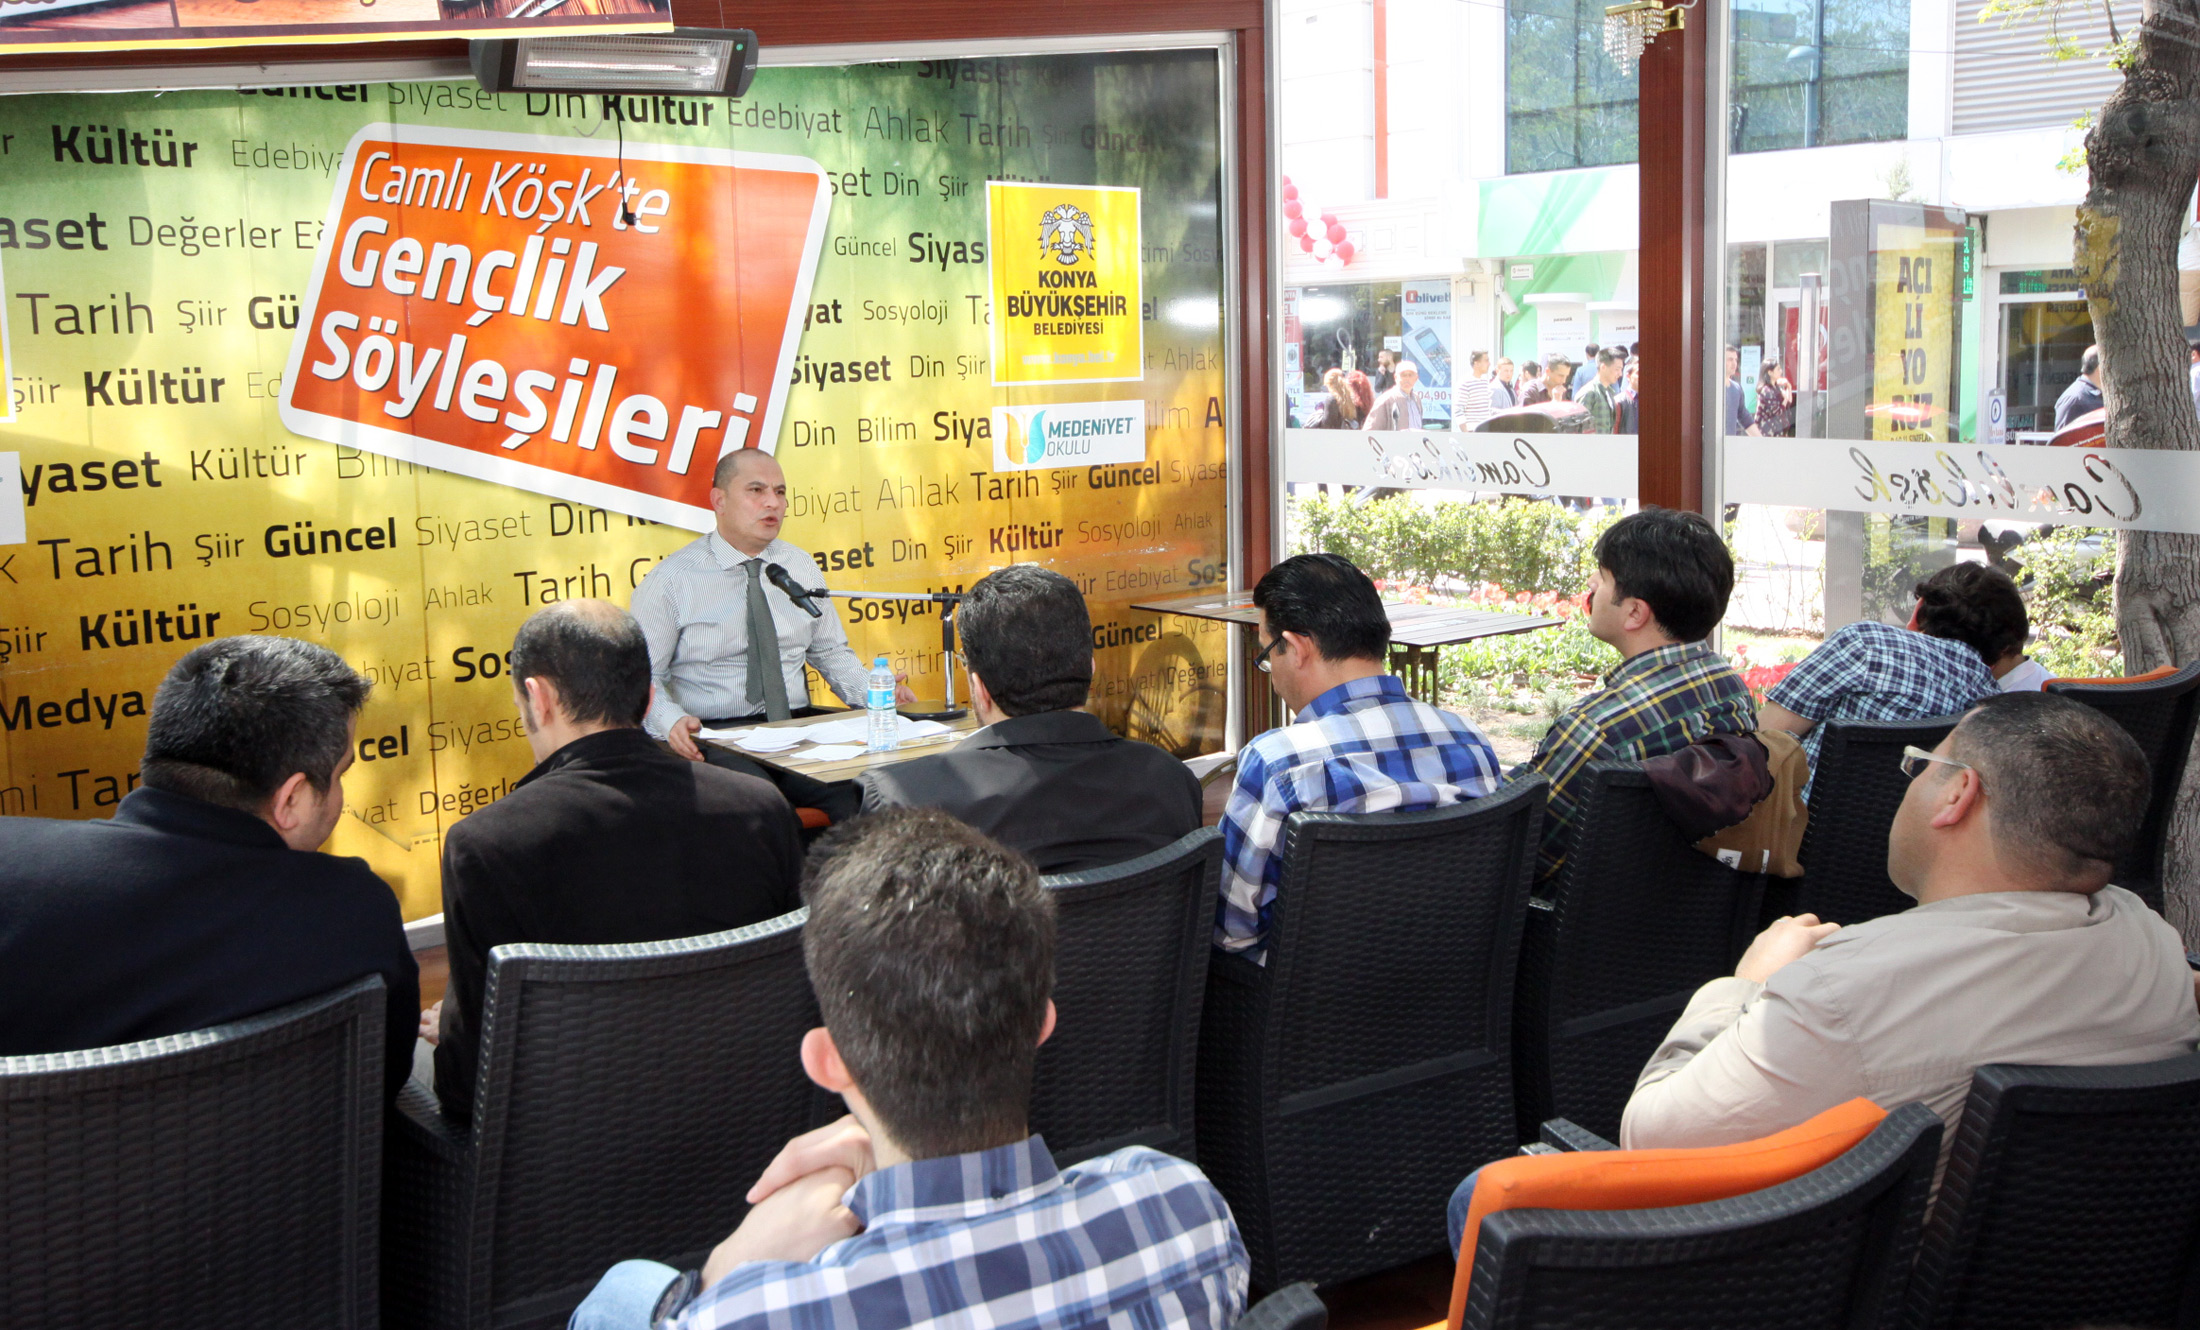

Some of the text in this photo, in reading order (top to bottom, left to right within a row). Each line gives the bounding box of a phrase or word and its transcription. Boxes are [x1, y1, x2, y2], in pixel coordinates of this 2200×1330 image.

[52, 124, 198, 168] Kültür
[864, 106, 949, 144] Ahlak
[959, 112, 1031, 148] Tarih
[728, 98, 842, 139] Edebiyat
[358, 149, 473, 214] Camlı
[129, 215, 283, 257] Değerler
[884, 171, 920, 197] Din
[939, 175, 969, 202] Şiir
[338, 215, 626, 332] Gençlik
[834, 231, 985, 272] Güncel Siyas
[1007, 290, 1127, 320] BÜYÜKŞEHİR
[1038, 270, 1097, 289] KONYA
[16, 292, 154, 336] Tarih
[176, 299, 228, 334] Şiir
[863, 299, 949, 326] Sosyoloji
[1033, 319, 1104, 336] BELEDİYESİ
[84, 366, 226, 407] Kültür
[910, 354, 945, 378] Din
[956, 355, 986, 381] Şiir
[1163, 346, 1218, 371] Ahlak
[1899, 347, 1927, 386] YO
[311, 310, 758, 477] Söyleşileri
[190, 446, 307, 481] Kültür
[793, 420, 836, 448] Din
[857, 416, 916, 444] Bilim
[1046, 439, 1091, 458] OKULU
[876, 475, 960, 511] Ahlak
[970, 469, 1040, 503] Tarih
[1050, 470, 1079, 496] Şiir
[1088, 460, 1161, 490] Güncel
[37, 530, 173, 580] Tarih
[194, 532, 245, 567] Şiir
[264, 516, 397, 559] Güncel
[415, 509, 532, 552] Siyaset
[549, 502, 609, 537] Din
[892, 538, 927, 563] Din
[944, 534, 974, 561] Şiir
[989, 521, 1064, 554] Kültür
[1078, 517, 1161, 547] Sosyoloji
[1173, 511, 1213, 532] Ahlak
[1106, 566, 1180, 592] Edebiyat
[80, 602, 221, 651] Kültür
[248, 588, 400, 634] Sosyoloji
[425, 581, 493, 611] Ahlak
[514, 562, 612, 607] Tarih
